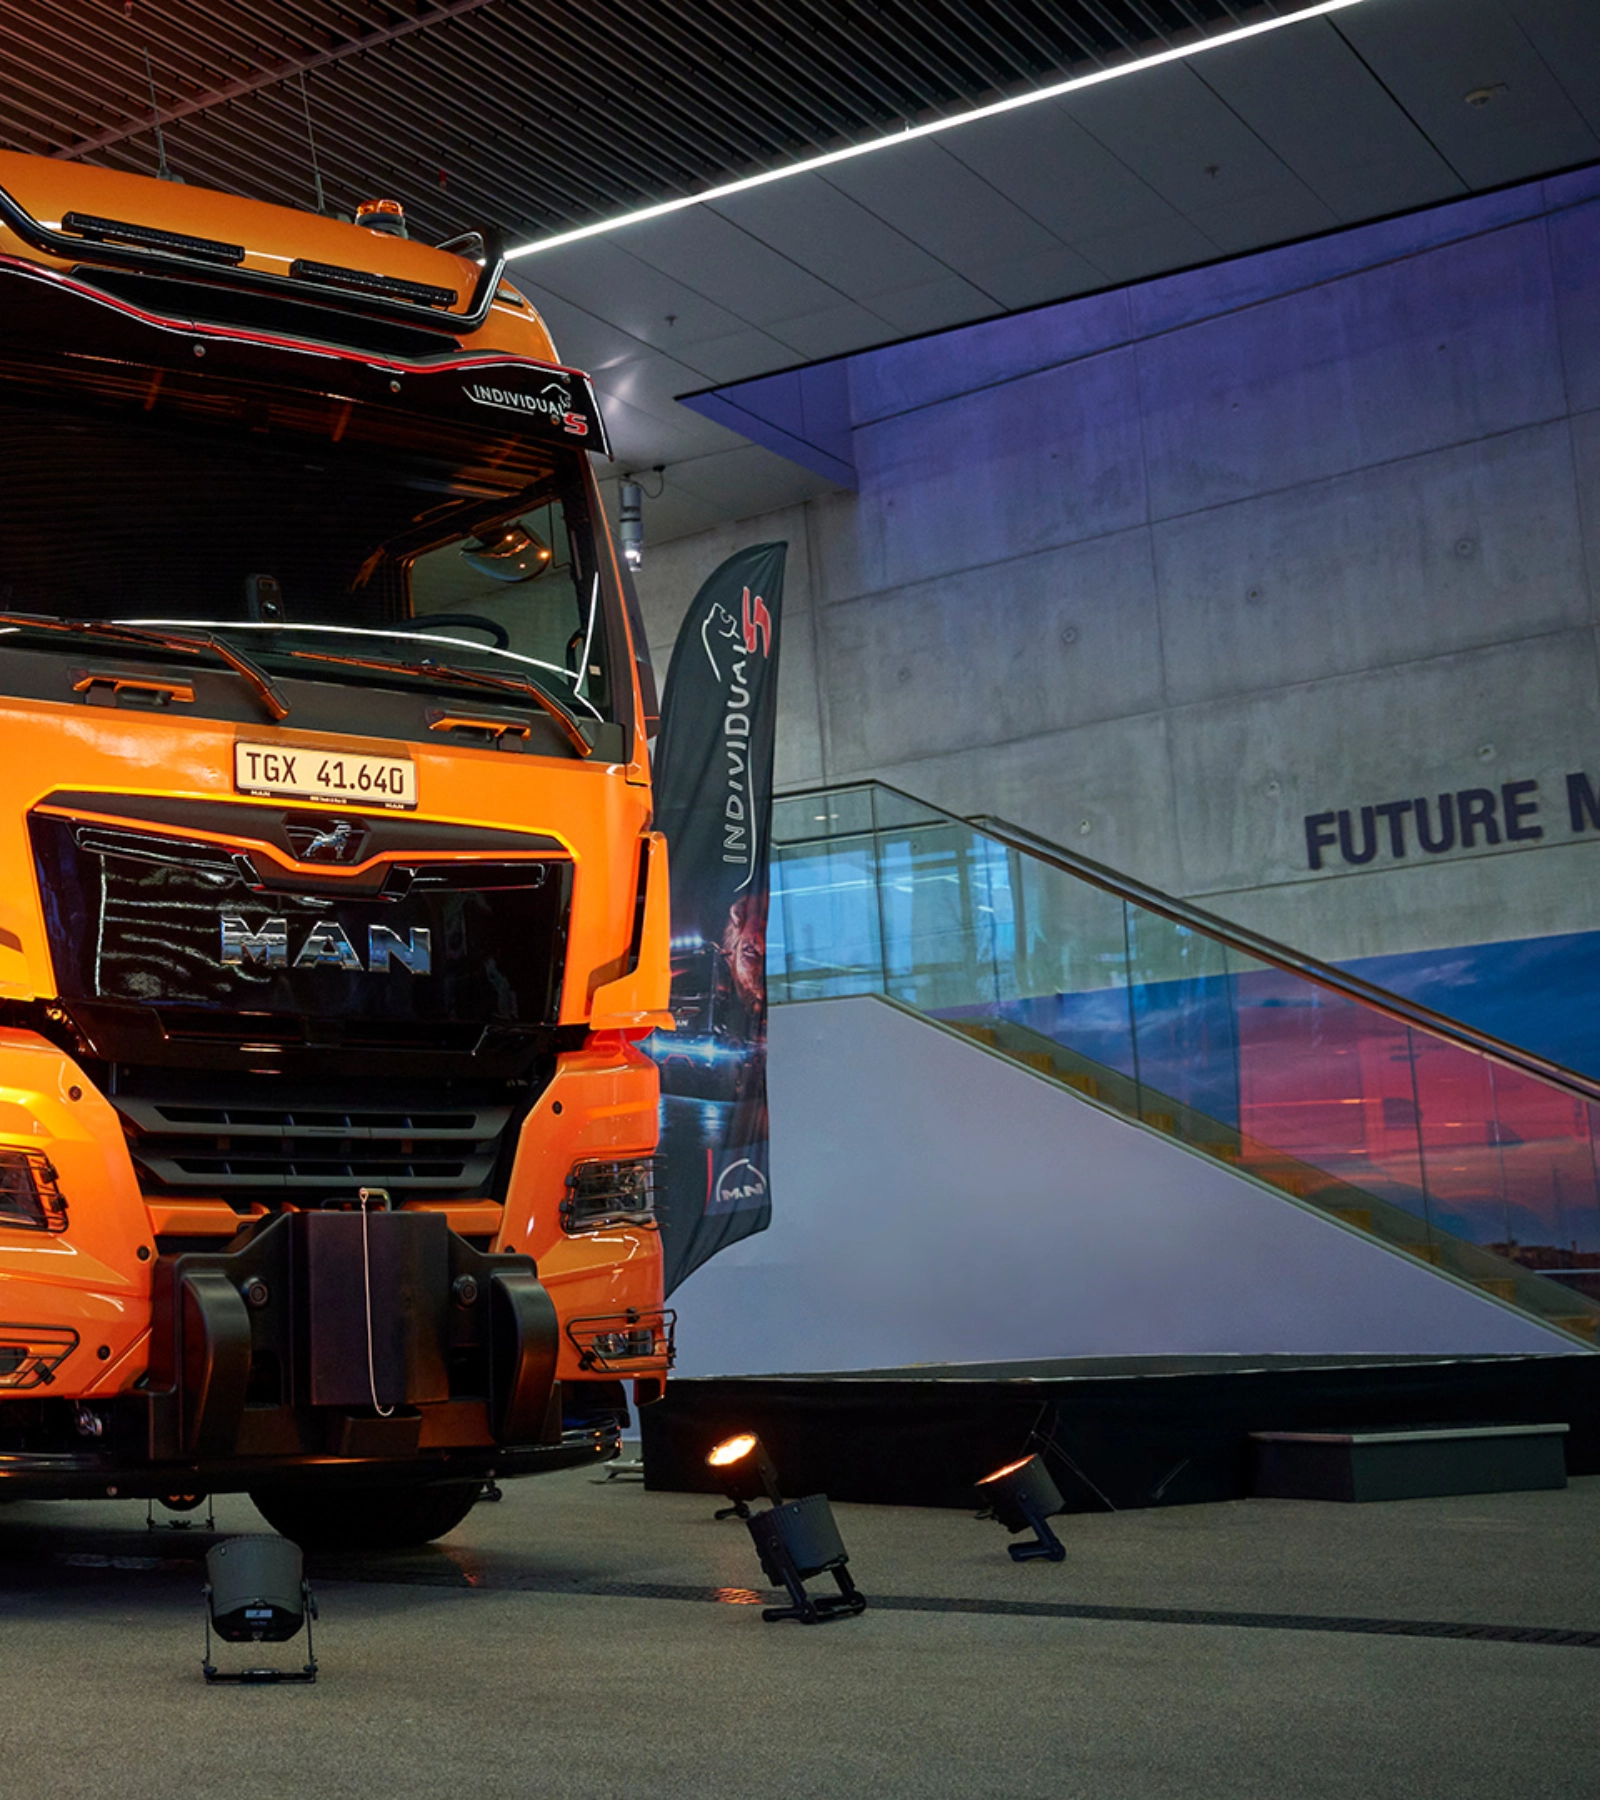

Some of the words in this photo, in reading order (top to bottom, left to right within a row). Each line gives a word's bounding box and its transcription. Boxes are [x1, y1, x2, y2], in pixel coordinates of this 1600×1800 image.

[473, 384, 566, 417] INDIVIDUAL
[564, 412, 588, 436] S
[723, 643, 750, 864] INDIVIDUAL
[742, 586, 772, 658] S
[246, 752, 298, 785] TGX
[316, 759, 404, 795] 41.640
[1304, 778, 1544, 870] FUTURE
[221, 914, 431, 975] MAN
[721, 1182, 764, 1201] MAN
